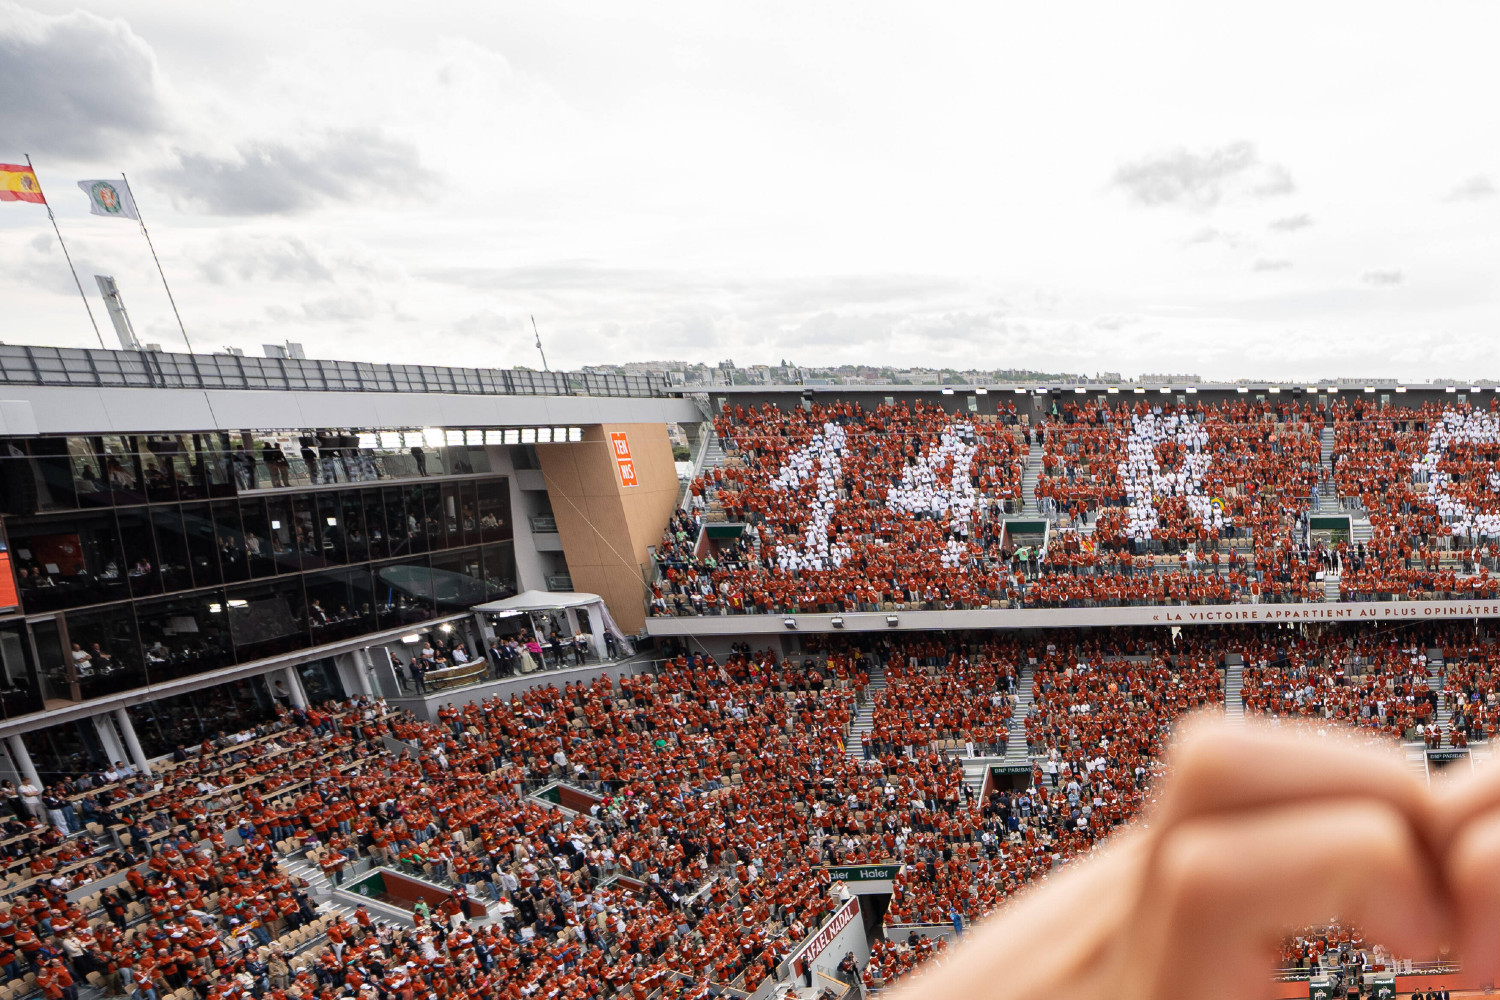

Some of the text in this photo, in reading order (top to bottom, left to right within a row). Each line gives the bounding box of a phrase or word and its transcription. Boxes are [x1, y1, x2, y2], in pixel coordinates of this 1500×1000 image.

[614, 439, 628, 455] TEN
[1166, 612, 1182, 621] LA
[1189, 611, 1258, 621] VICTOIRE
[1266, 609, 1352, 619] APPARTIENT
[1359, 608, 1377, 617] AU
[1385, 607, 1416, 616] PLUS
[1424, 604, 1499, 616] OPINIÂTRE
[830, 869, 888, 879] aier Haier
[828, 906, 854, 939] NADAL
